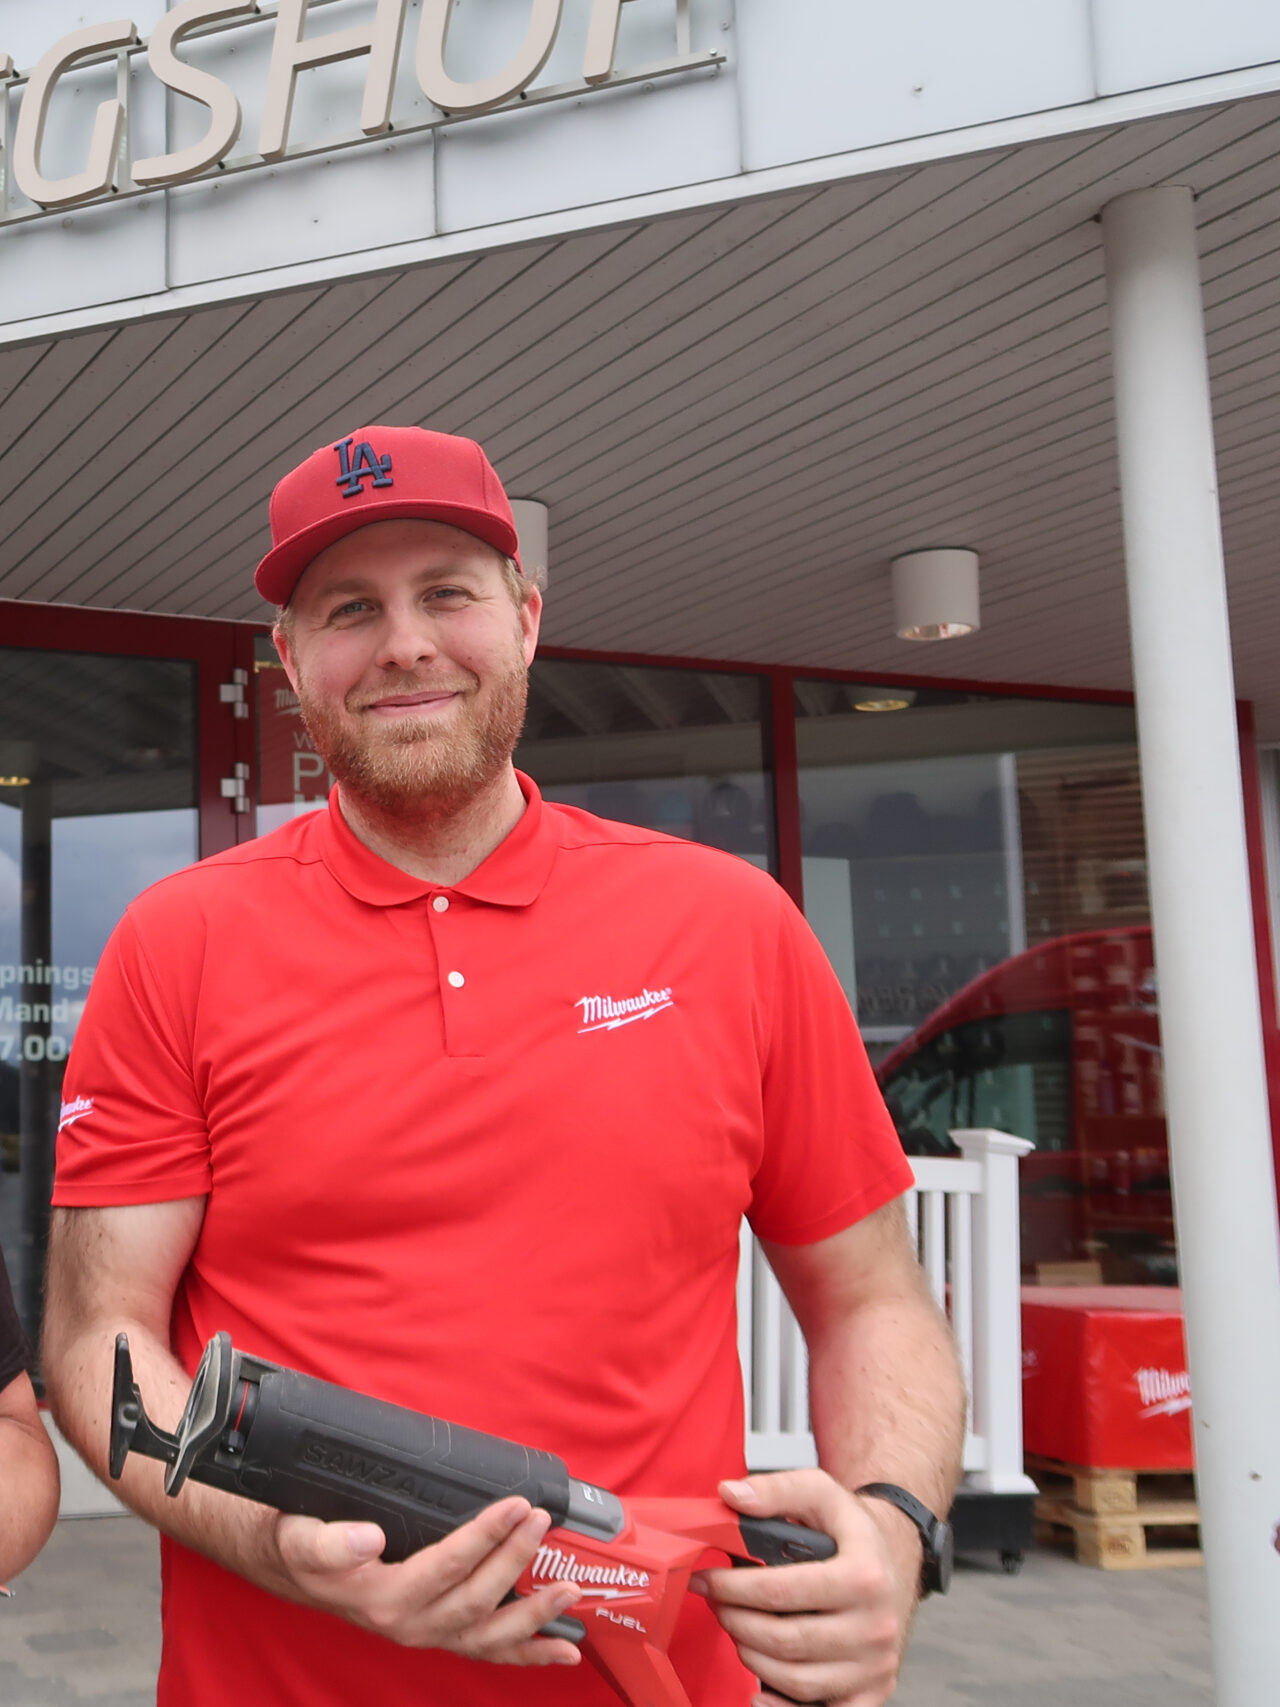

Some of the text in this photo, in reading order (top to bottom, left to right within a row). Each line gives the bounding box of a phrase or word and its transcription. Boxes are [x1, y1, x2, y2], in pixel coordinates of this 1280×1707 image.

[334, 438, 393, 498] LA
[574, 988, 672, 1024] Milwaukee
[303, 1443, 453, 1515] SAWZALL
[532, 1545, 650, 1587] Milwaukee
[595, 1607, 647, 1633] FUEL
